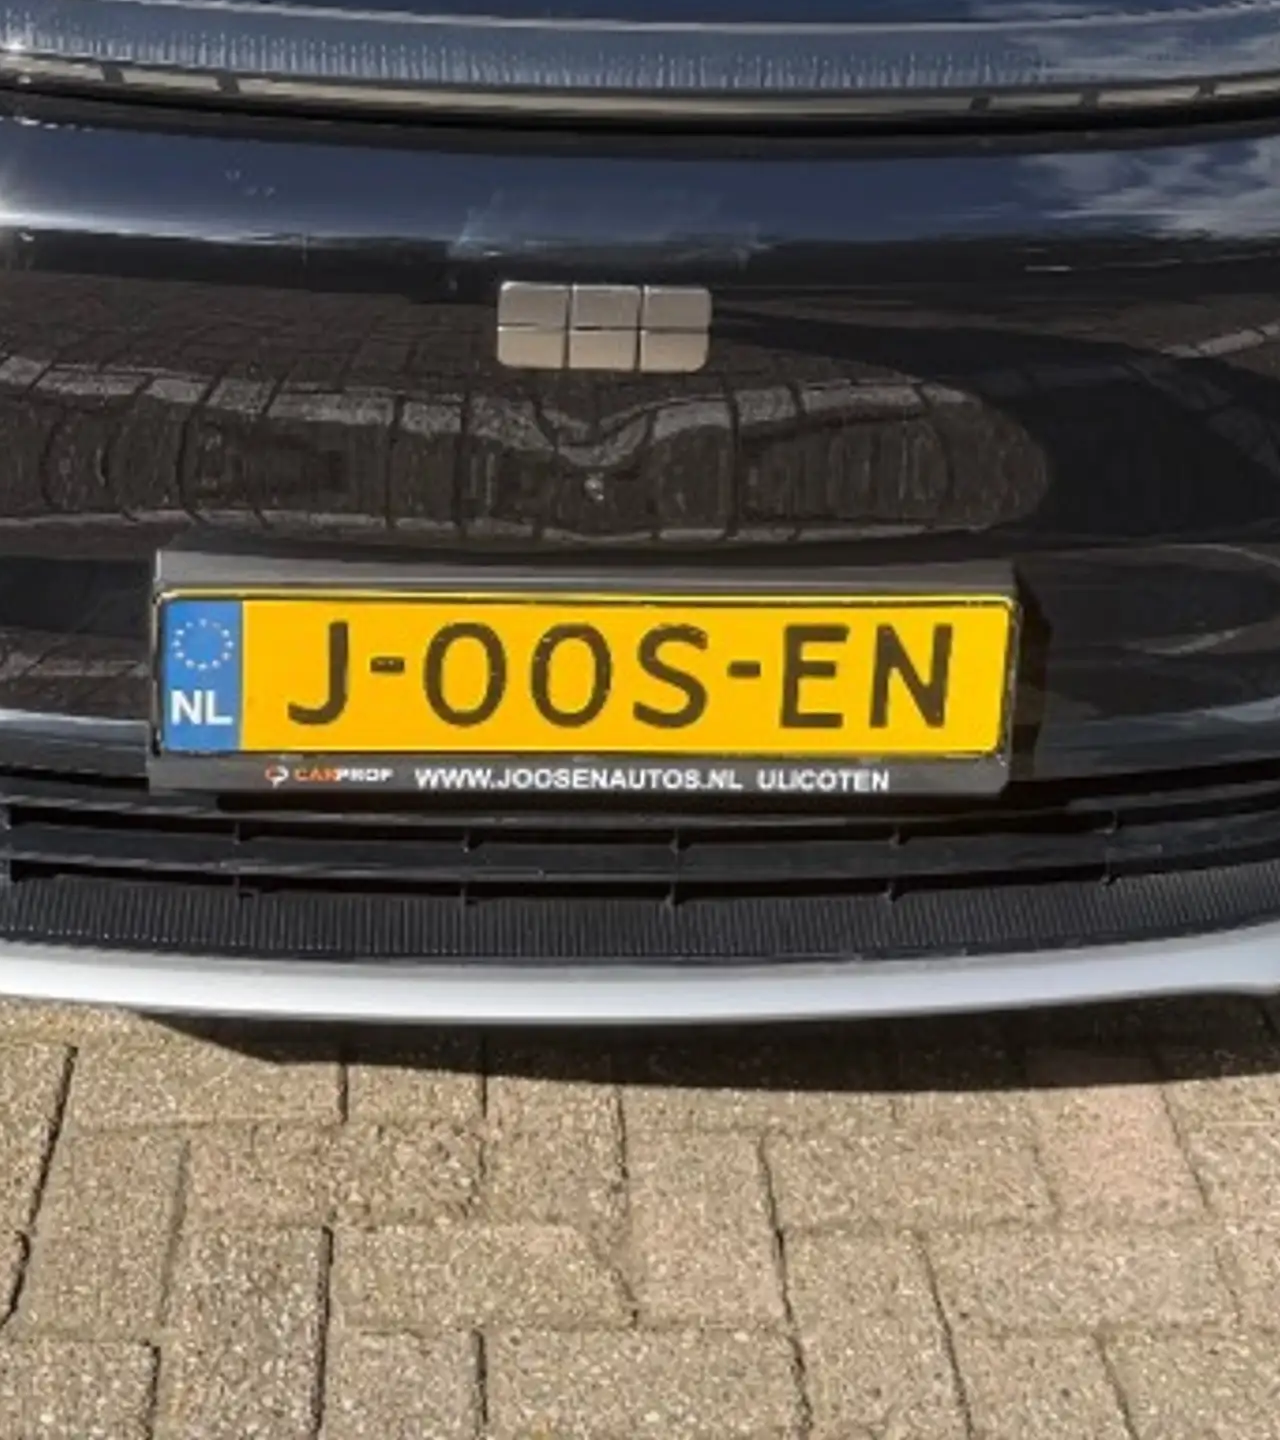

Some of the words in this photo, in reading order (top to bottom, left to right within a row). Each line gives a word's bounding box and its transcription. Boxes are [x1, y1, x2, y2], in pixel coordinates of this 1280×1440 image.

[171, 689, 234, 726] NL
[415, 767, 743, 791] WWW.JOOSENAUTOS.NL
[756, 768, 890, 792] ULICOTEN
